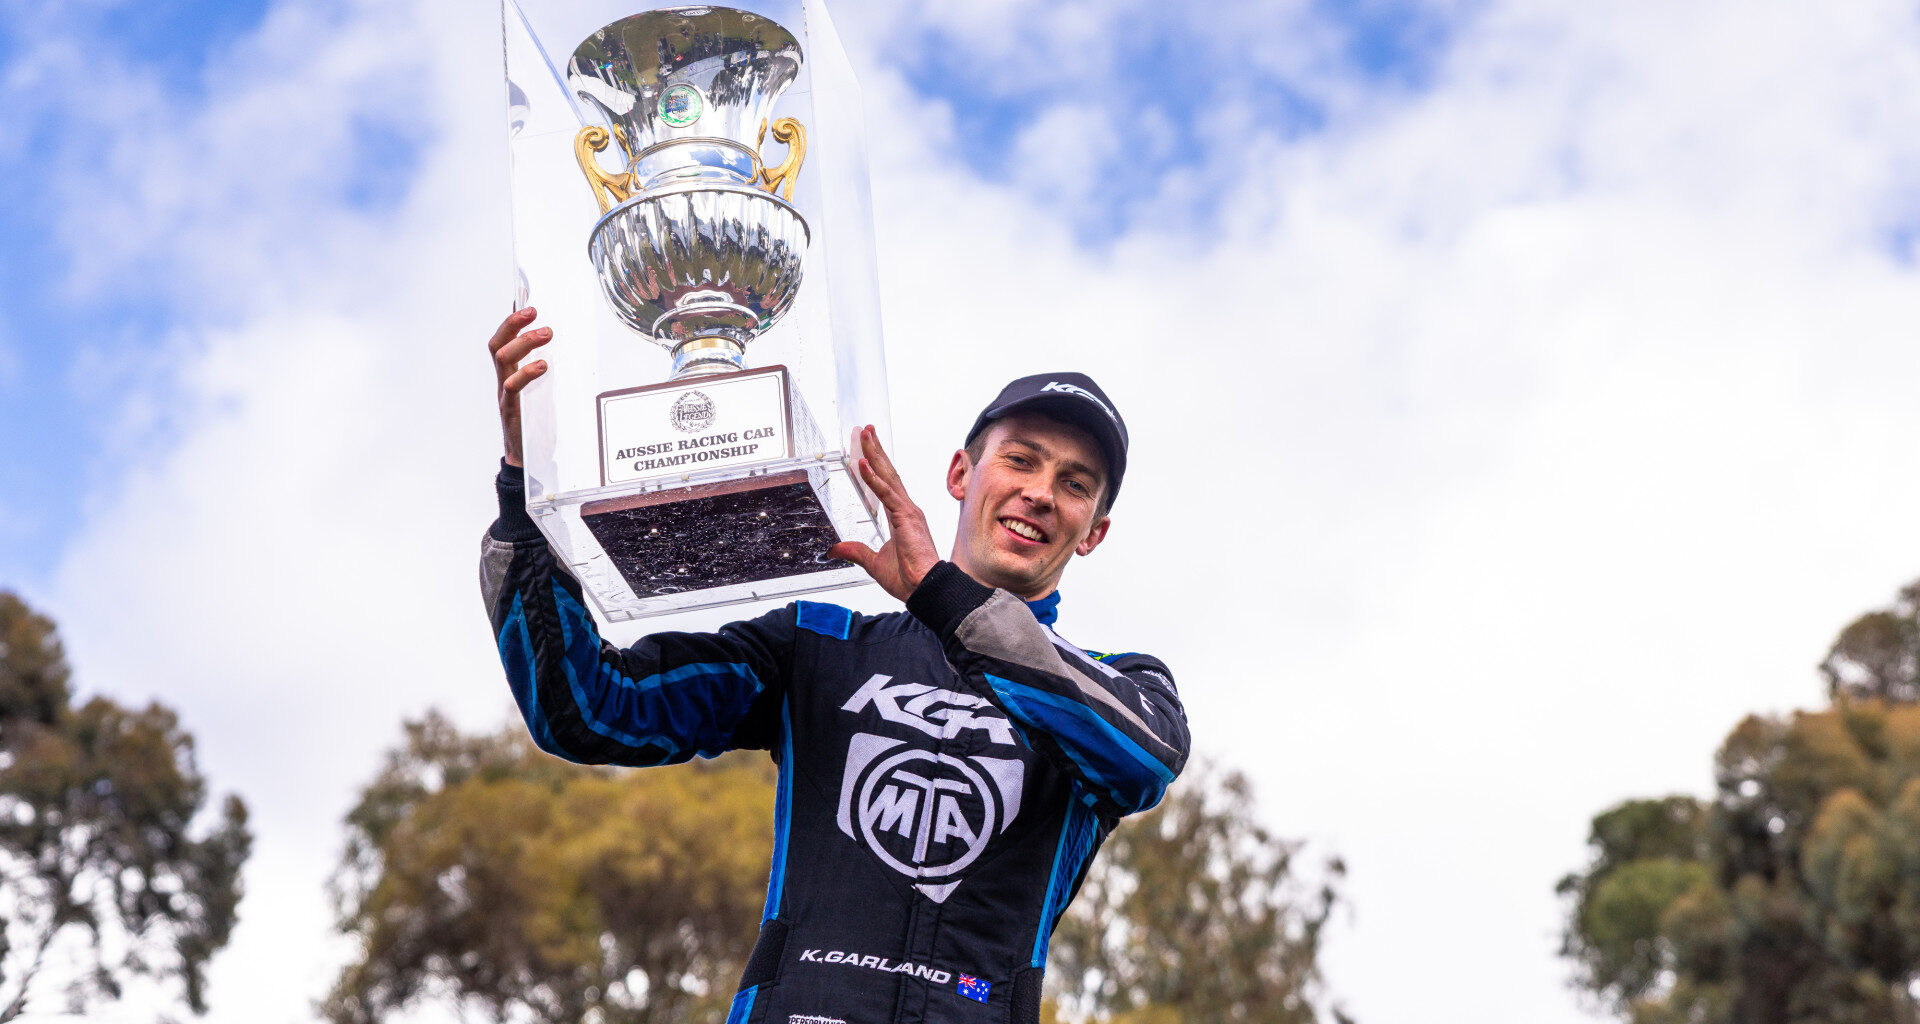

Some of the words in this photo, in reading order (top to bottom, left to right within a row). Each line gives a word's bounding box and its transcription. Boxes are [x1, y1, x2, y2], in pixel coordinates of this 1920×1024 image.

[616, 442, 673, 460] AUSSIE
[677, 432, 738, 451] RACING
[743, 426, 775, 440] CAR
[633, 443, 759, 472] CHAMPIONSHIP
[867, 769, 978, 864] MTA
[800, 949, 951, 984] K.GARLAND
